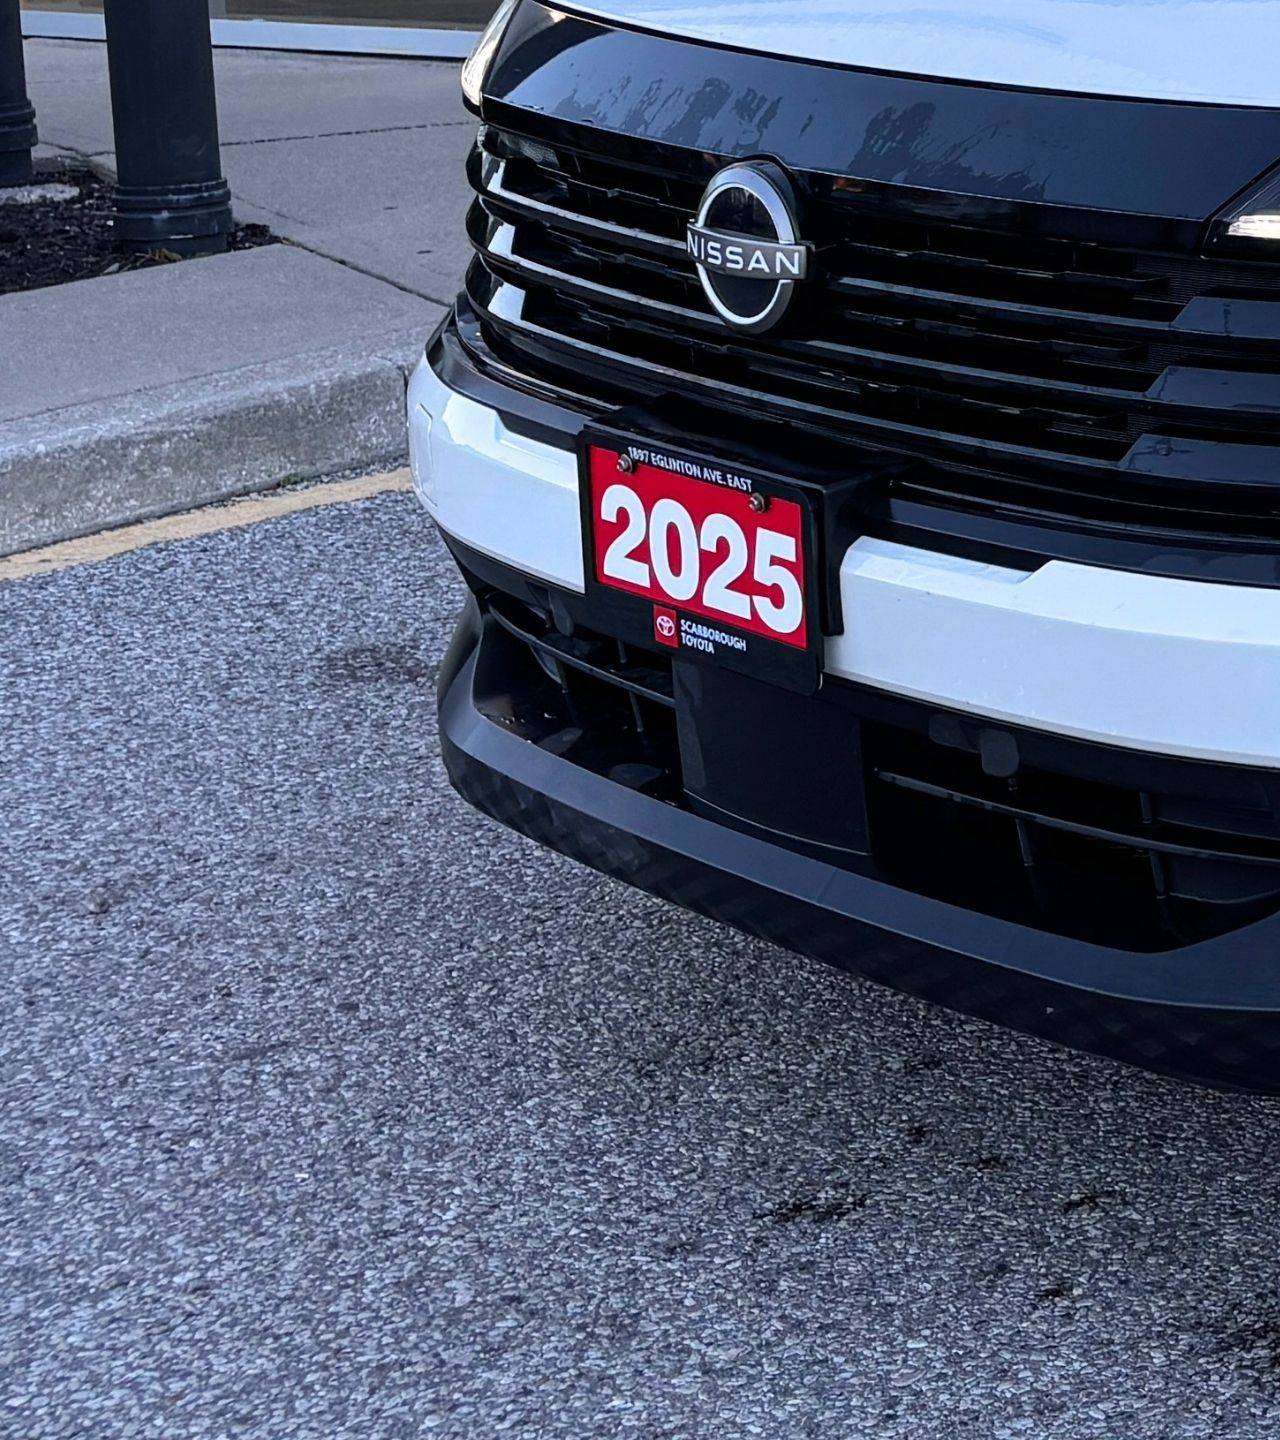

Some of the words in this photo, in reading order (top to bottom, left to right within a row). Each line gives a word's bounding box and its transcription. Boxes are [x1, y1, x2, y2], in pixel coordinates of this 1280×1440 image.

[687, 230, 800, 274] NISSAN
[650, 453, 701, 478] EGLINTON
[727, 474, 752, 493] EAST
[600, 484, 803, 633] 2025
[680, 619, 746, 651] SCARBOROUGH
[681, 632, 715, 654] TOYOTA
